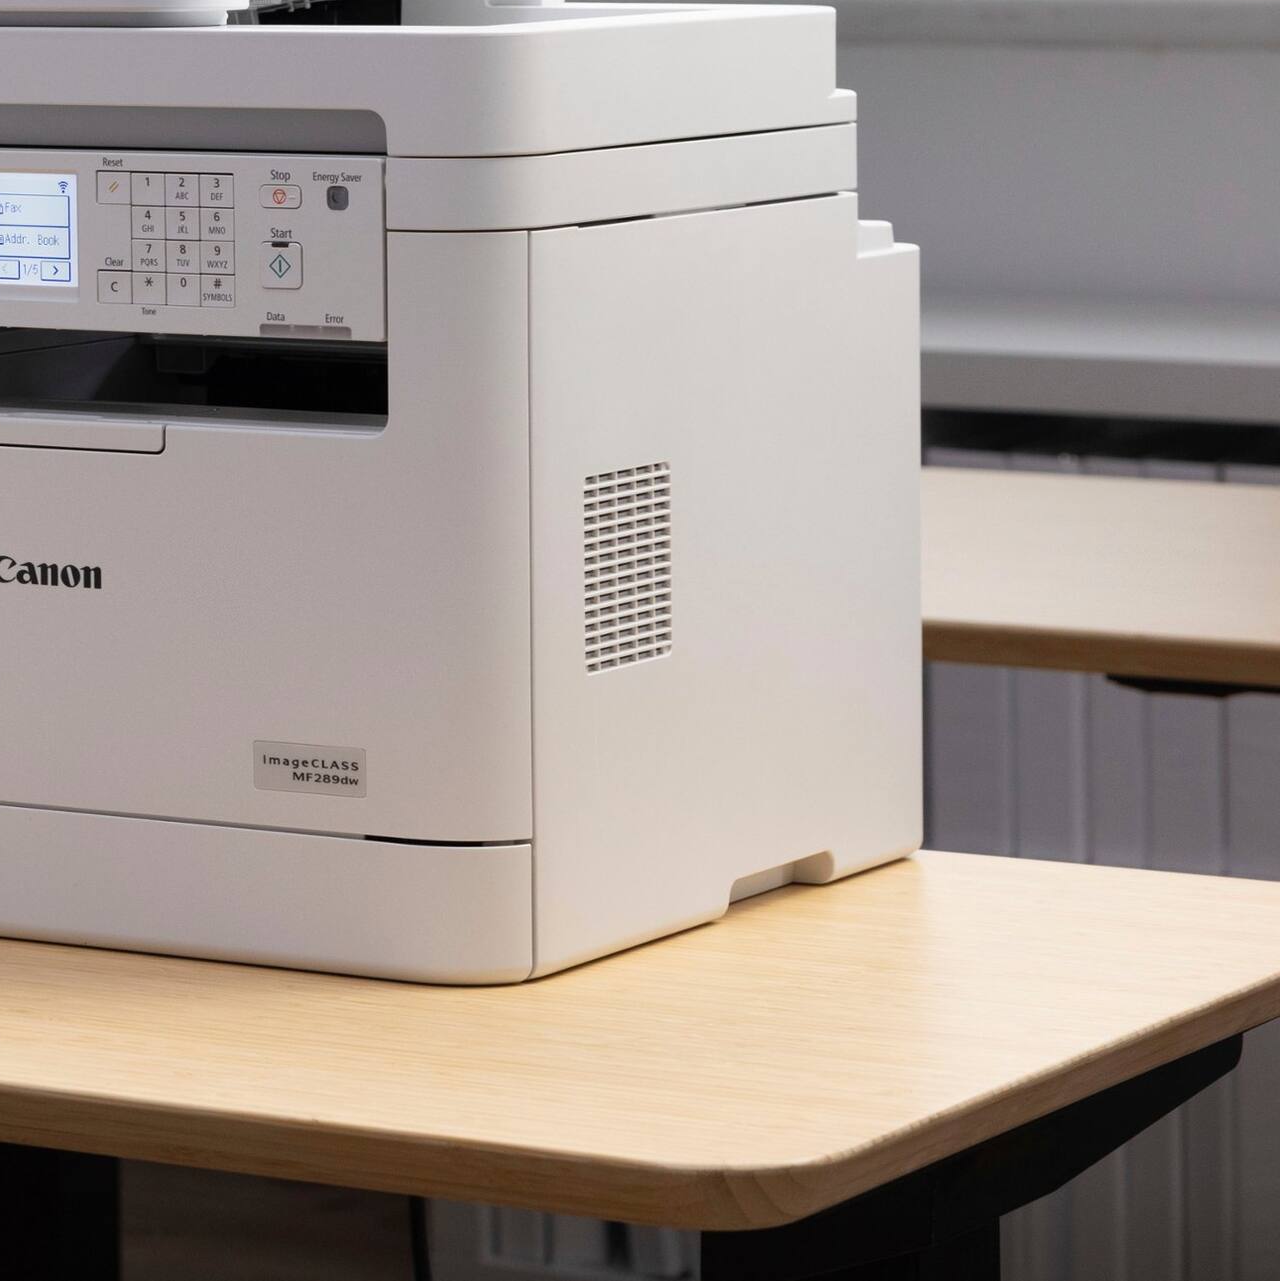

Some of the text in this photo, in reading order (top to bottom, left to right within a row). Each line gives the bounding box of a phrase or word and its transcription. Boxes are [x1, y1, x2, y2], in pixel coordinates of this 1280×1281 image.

[103, 157, 123, 167] Reset
[271, 169, 290, 182] Stop
[313, 172, 361, 184] Energy Saver
[145, 177, 150, 186] 1
[179, 177, 184, 187] 2
[214, 178, 220, 188] 3
[175, 192, 189, 200] ABC
[5, 202, 21, 212] Fax
[145, 210, 151, 219] 4
[180, 211, 185, 221] 5
[214, 212, 220, 221] 6
[142, 224, 154, 232] GHI
[208, 226, 225, 234] MNO
[271, 228, 292, 238] Start
[5, 233, 60, 246] Addr. Book
[146, 244, 152, 253] 7
[180, 245, 186, 254] 8
[214, 246, 220, 256] 9
[105, 257, 123, 266] Clear
[140, 258, 158, 266] PQRS
[207, 260, 227, 269] WXYZ
[22, 263, 38, 275] 1/5
[111, 282, 118, 292] C
[180, 277, 187, 287] 0
[214, 278, 222, 289] #
[203, 293, 232, 302] SYMBOLS
[142, 307, 156, 315] Tone
[267, 312, 285, 321] Data
[325, 314, 344, 324] Error
[293, 772, 358, 785] MF289dw
